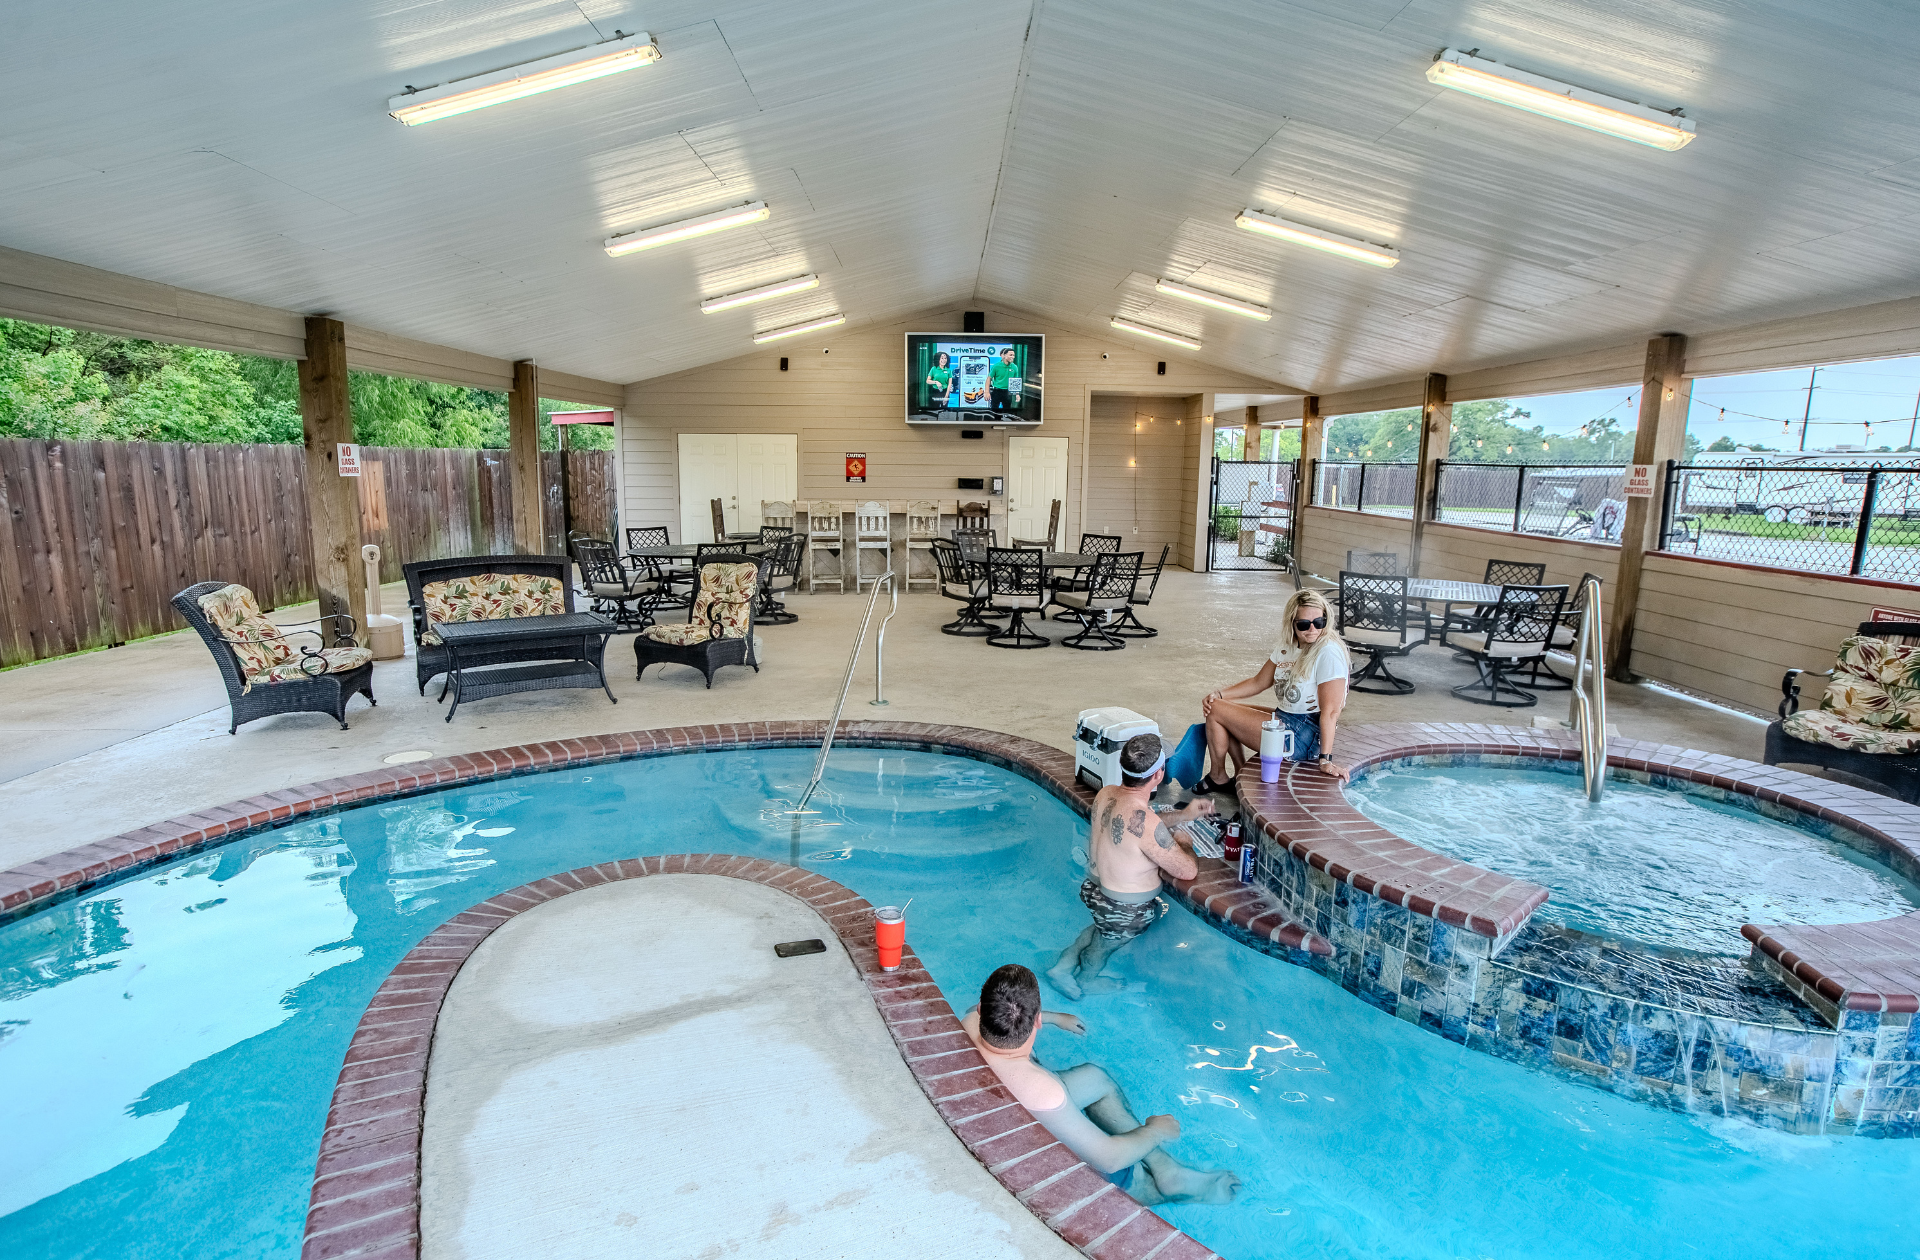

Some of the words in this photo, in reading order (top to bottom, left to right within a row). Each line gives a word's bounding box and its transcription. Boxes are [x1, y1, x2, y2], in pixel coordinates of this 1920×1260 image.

[1634, 467, 1647, 478] NO
[1629, 478, 1649, 487] GLASS
[1624, 486, 1653, 495] CONTAINERS
